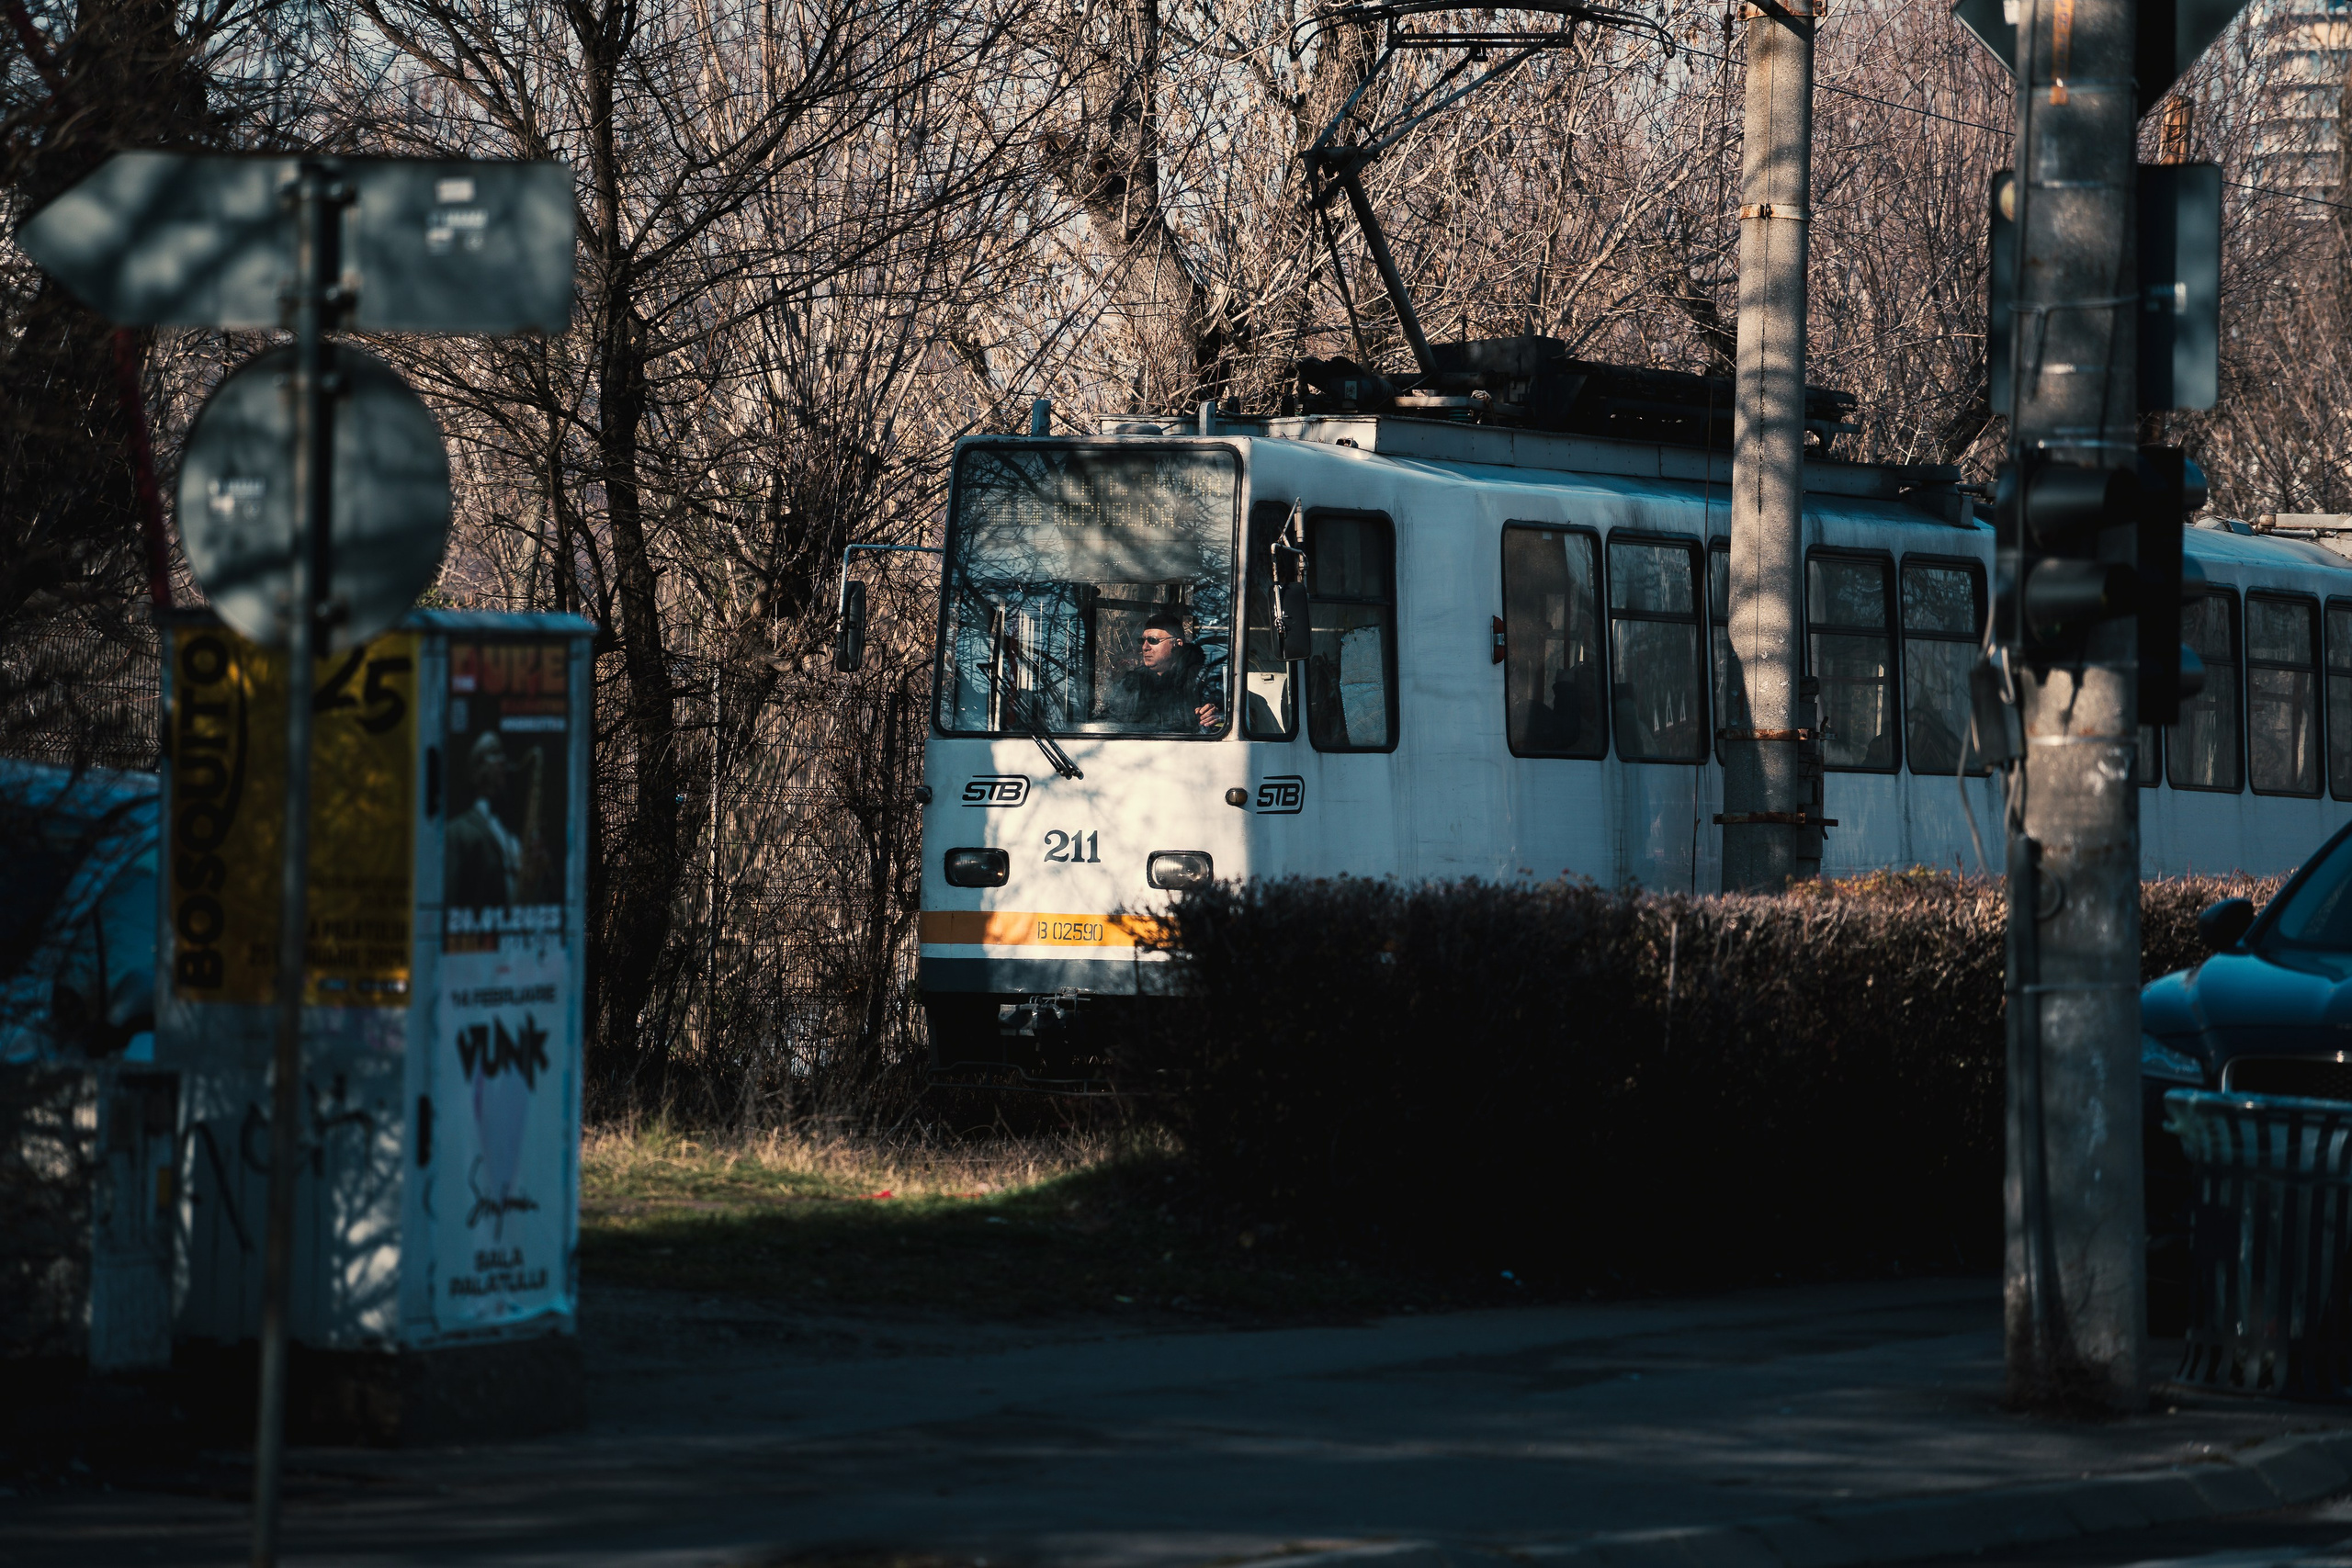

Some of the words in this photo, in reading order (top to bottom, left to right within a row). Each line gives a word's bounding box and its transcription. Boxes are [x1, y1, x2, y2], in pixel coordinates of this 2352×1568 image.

[1053, 502, 1175, 528] REPUBLICA
[962, 780, 1026, 804] STB
[1257, 781, 1303, 808] STB
[1044, 829, 1102, 863] 211
[1037, 920, 1047, 940] B
[1052, 921, 1103, 942] 02590
